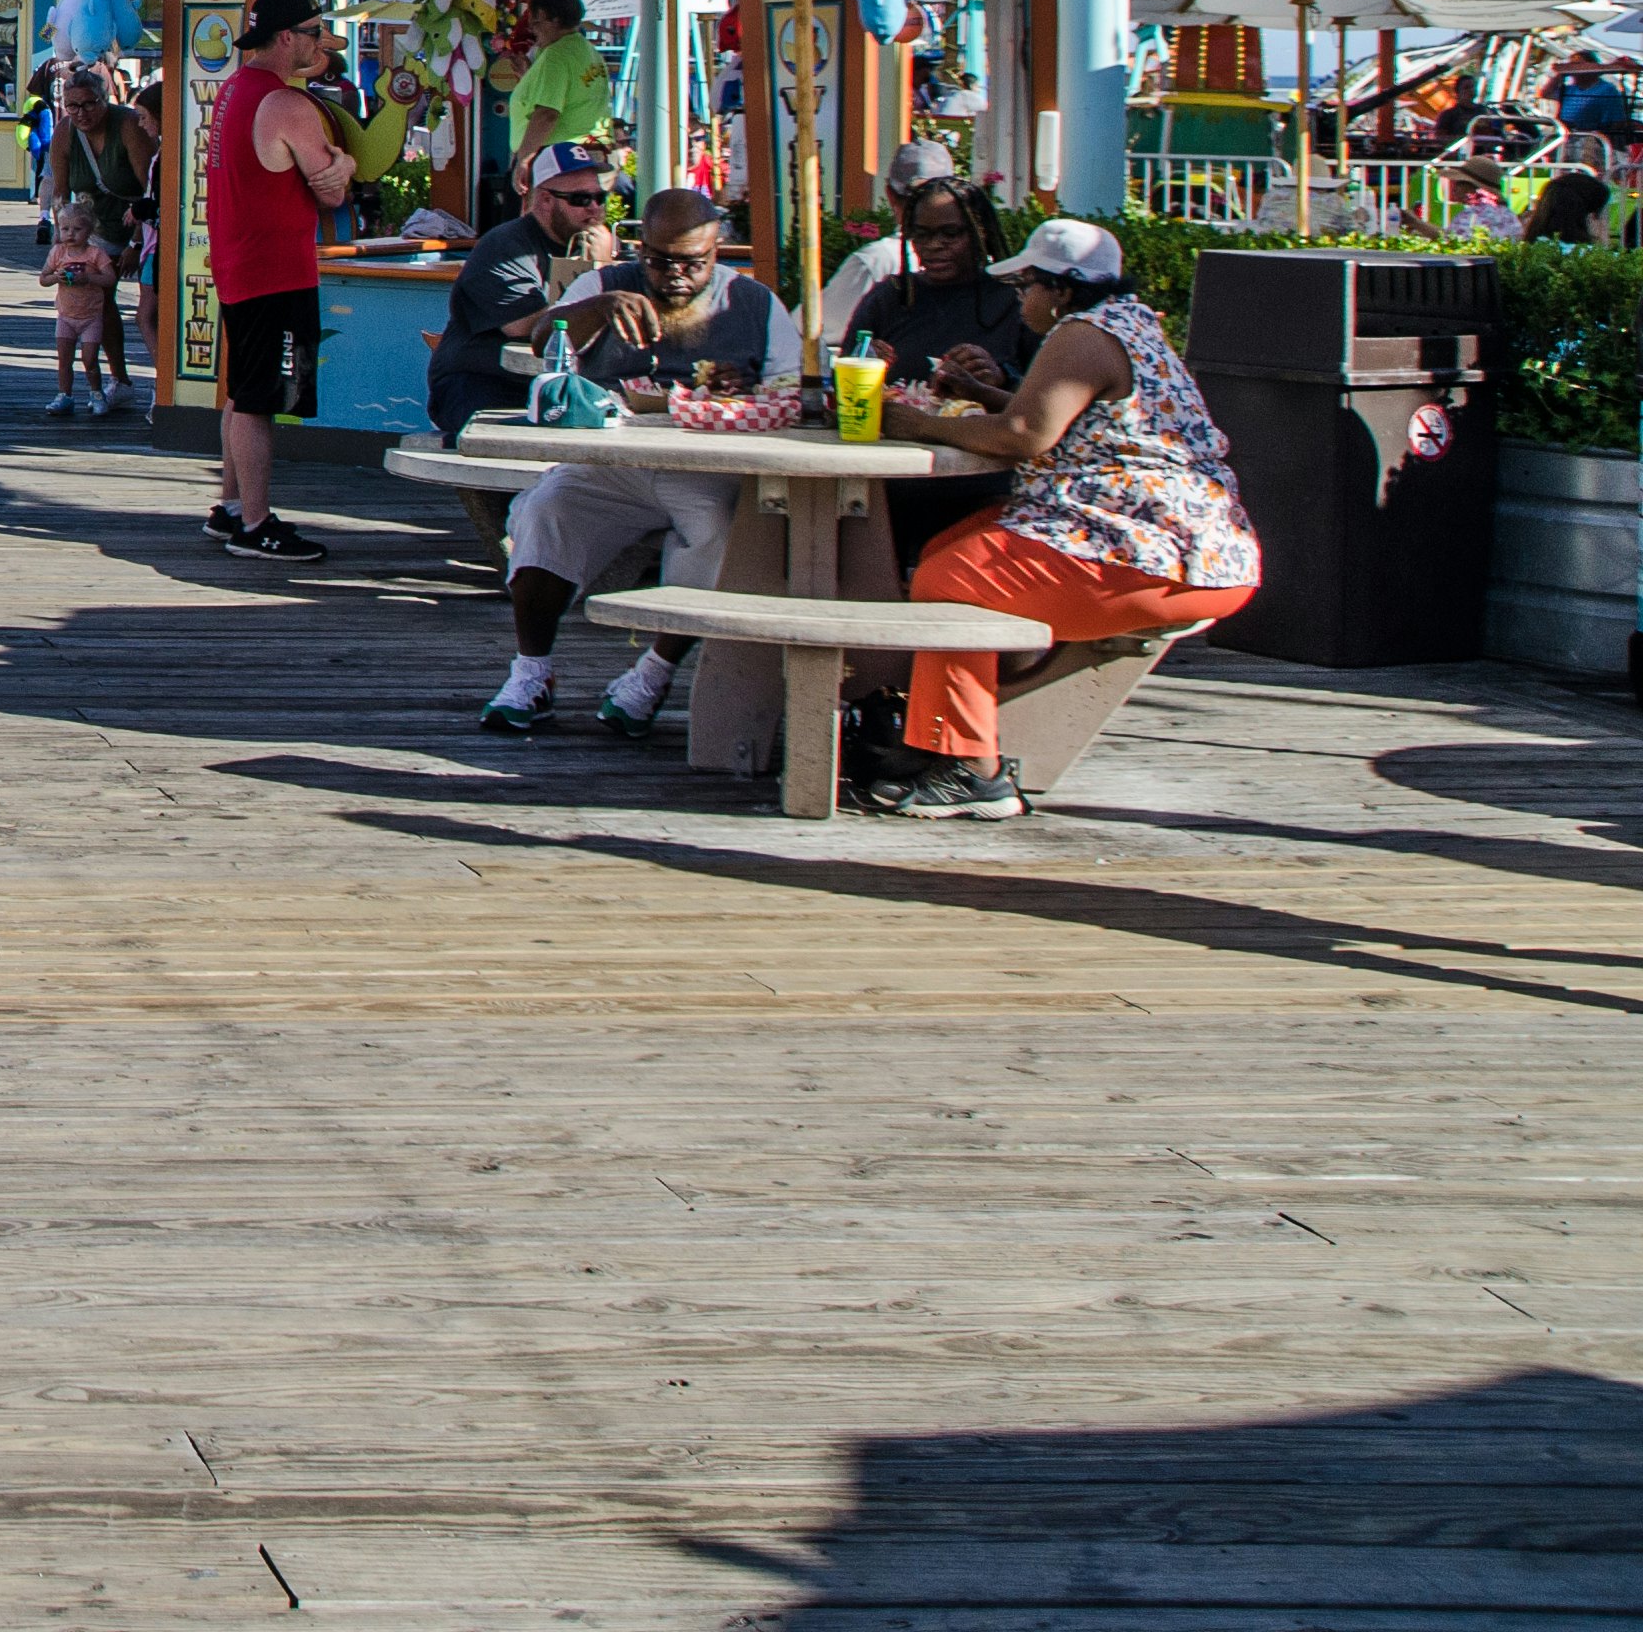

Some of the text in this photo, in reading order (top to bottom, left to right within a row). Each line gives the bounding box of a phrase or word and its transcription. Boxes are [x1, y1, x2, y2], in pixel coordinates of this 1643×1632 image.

[210, 92, 231, 169] FREEDOM
[186, 274, 214, 369] TIME
[281, 330, 294, 376] AND1
